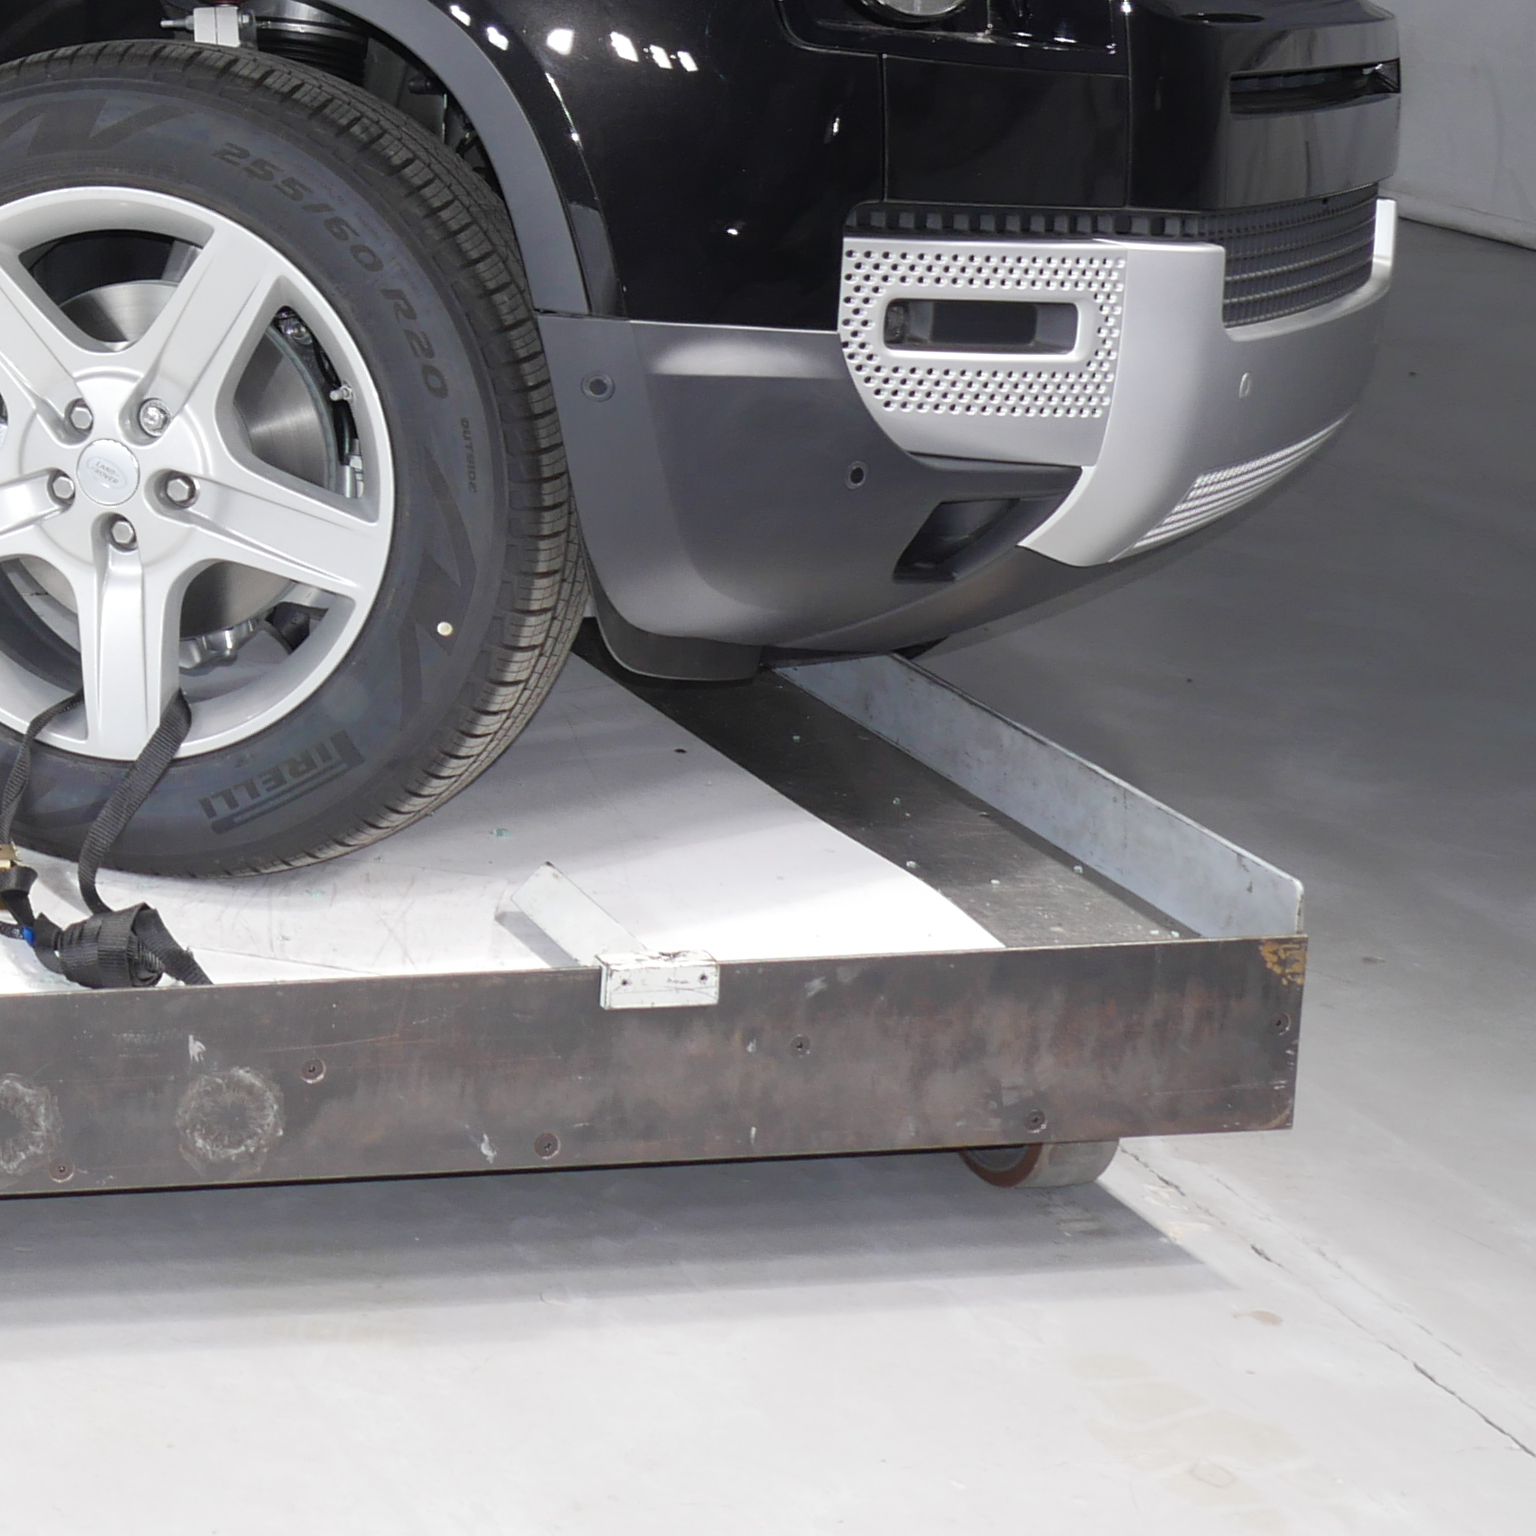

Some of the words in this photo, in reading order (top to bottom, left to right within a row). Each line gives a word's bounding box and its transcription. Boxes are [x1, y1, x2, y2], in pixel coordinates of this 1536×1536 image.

[211, 142, 385, 273] 255/60
[378, 287, 450, 399] R20
[198, 729, 366, 835] PIRELLI
